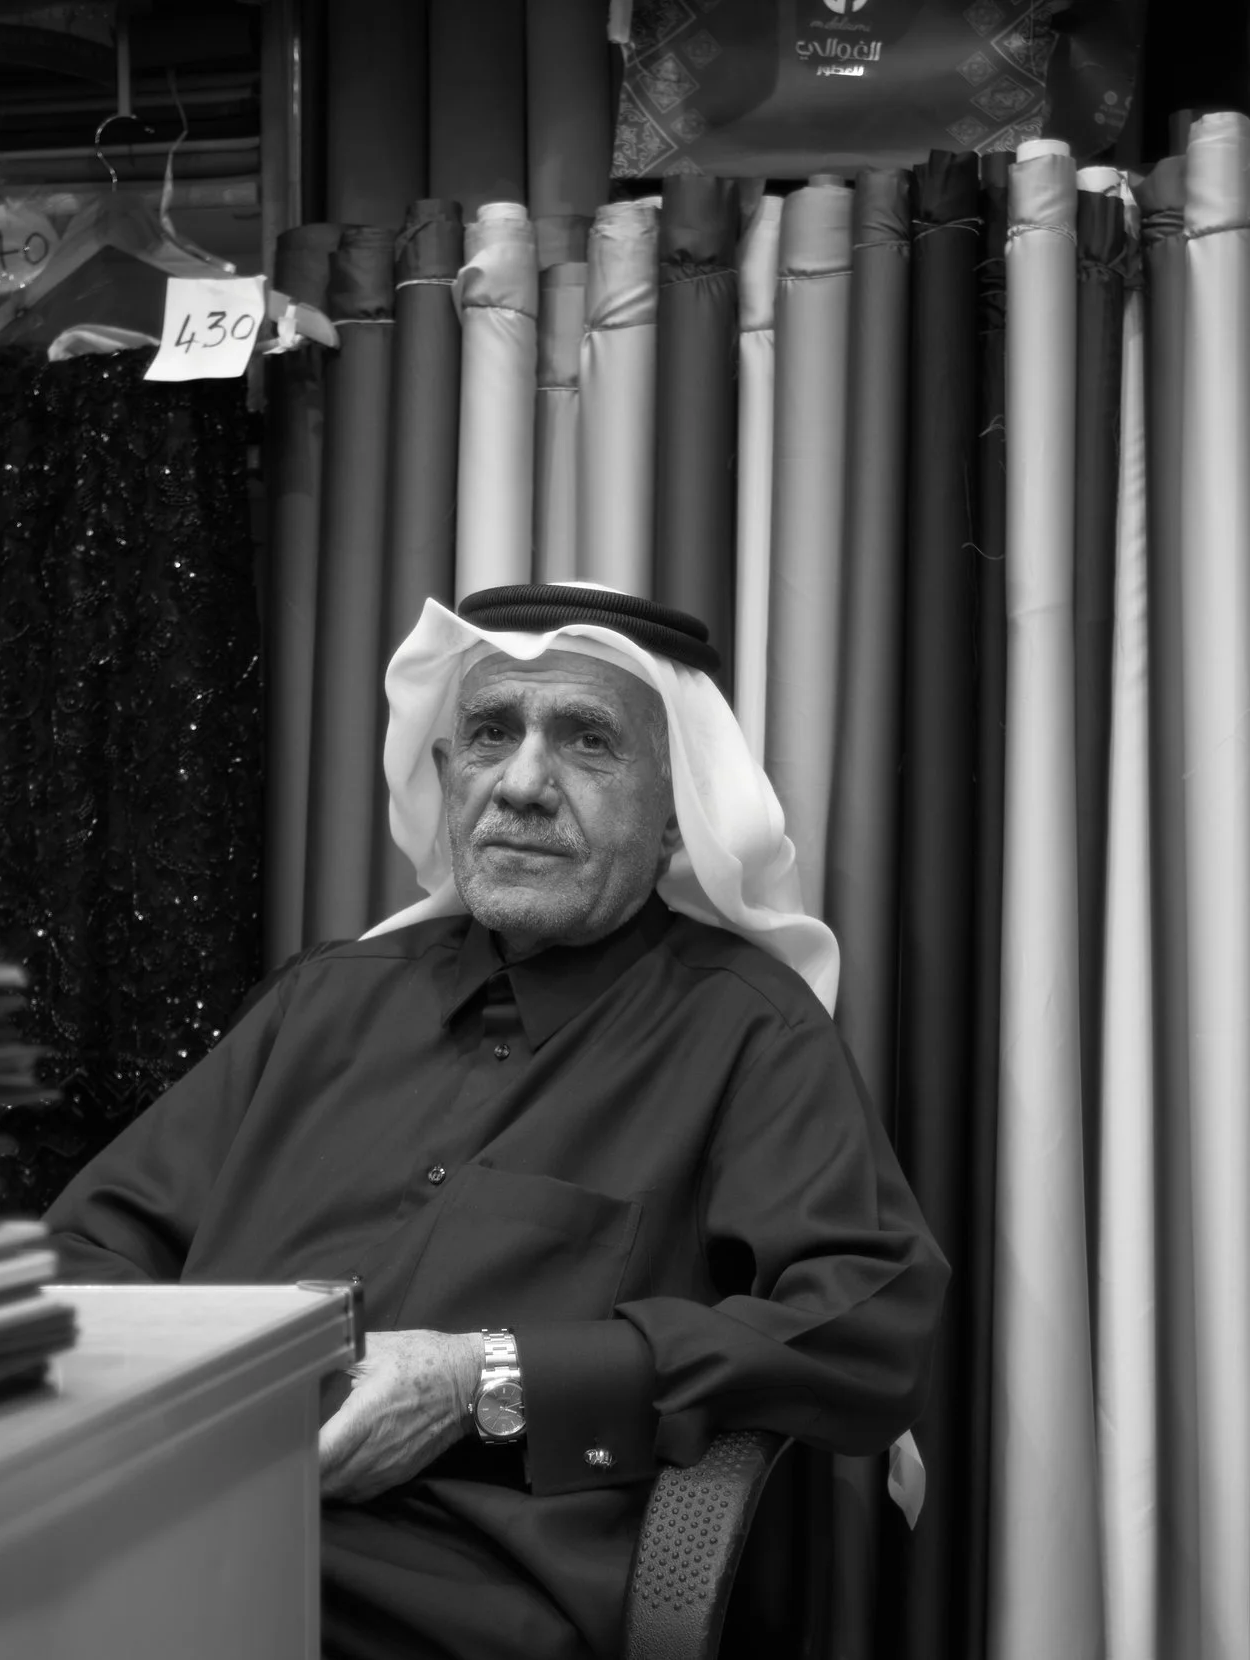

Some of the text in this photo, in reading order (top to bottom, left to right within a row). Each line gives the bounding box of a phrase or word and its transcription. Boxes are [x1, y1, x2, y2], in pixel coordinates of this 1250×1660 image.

[795, 37, 883, 61] الغوالي
[816, 64, 865, 76] للعطور
[173, 309, 255, 355] 430
